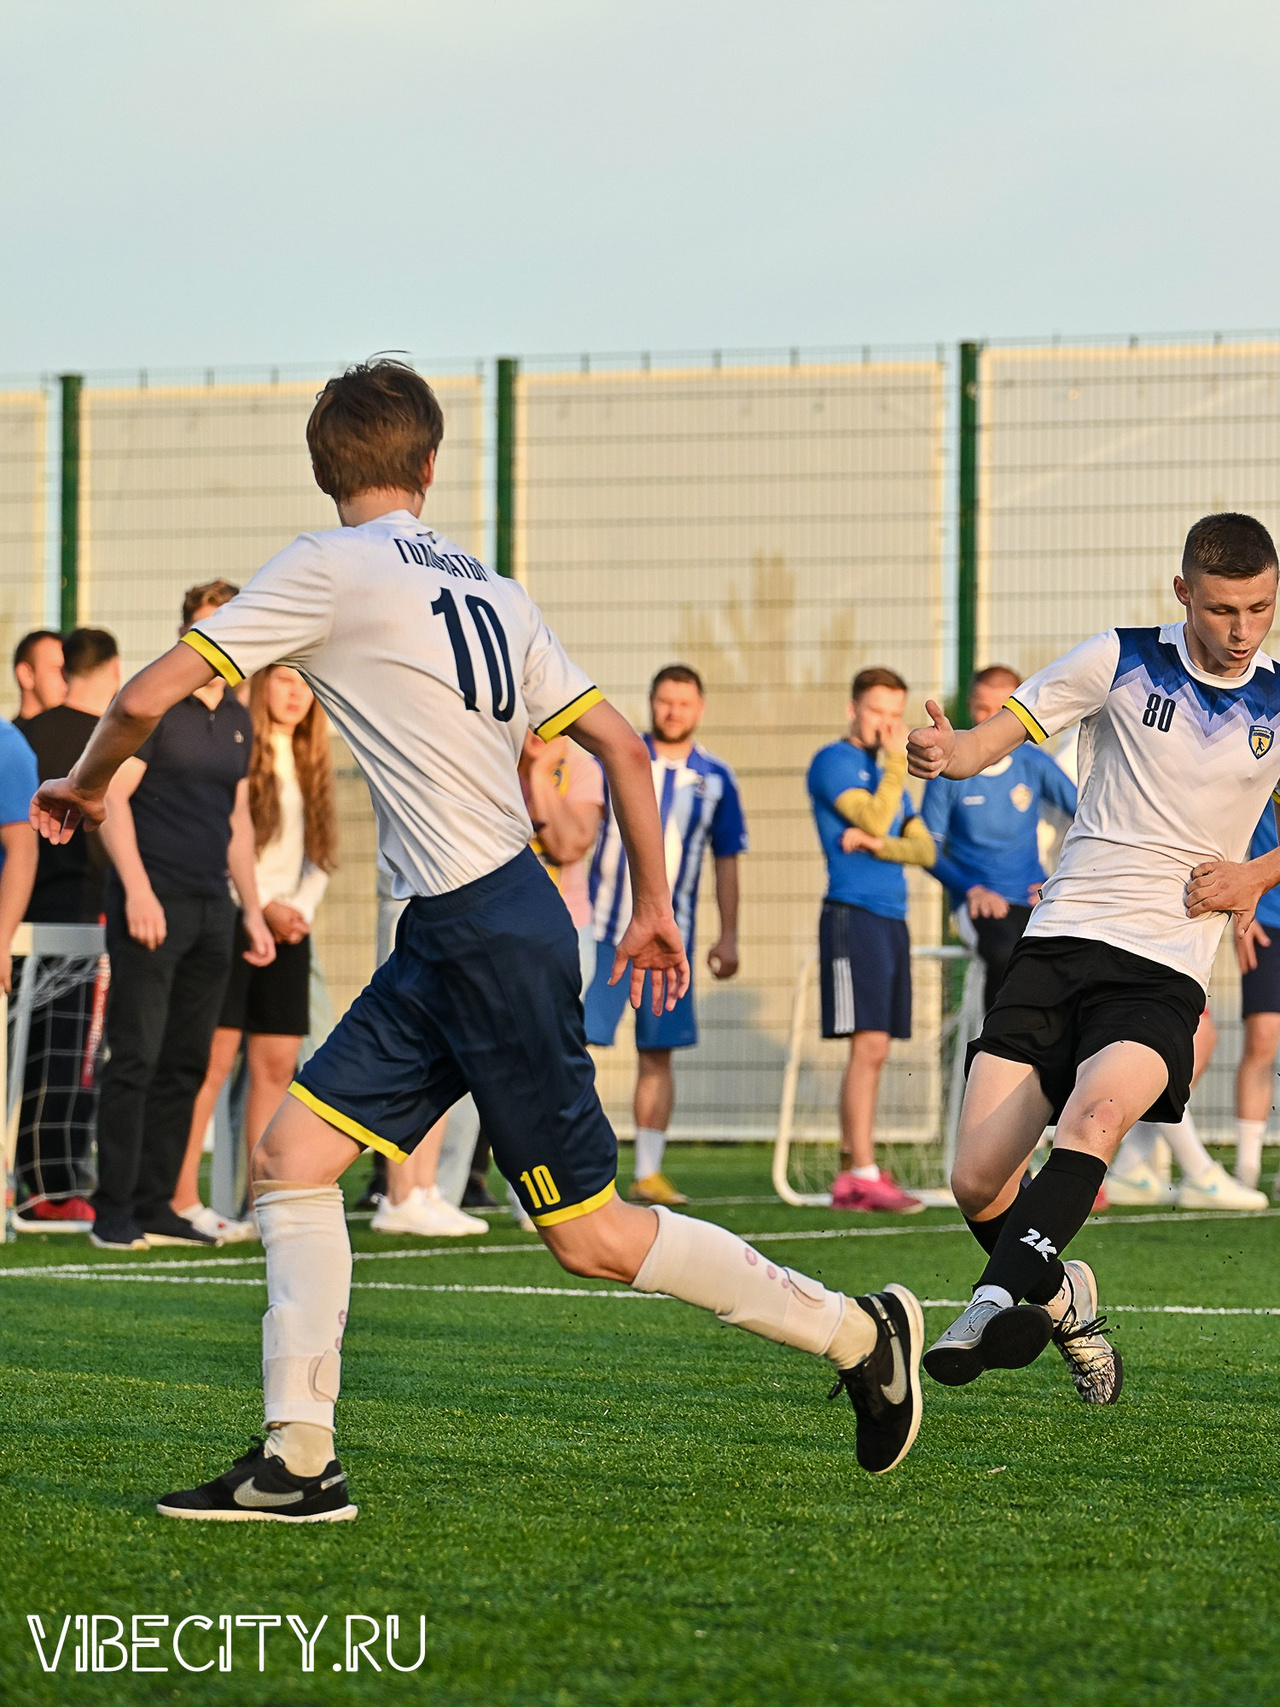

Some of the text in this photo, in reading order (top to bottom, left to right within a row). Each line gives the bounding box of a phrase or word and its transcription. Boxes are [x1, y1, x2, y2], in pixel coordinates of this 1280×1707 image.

[430, 586, 516, 723] 10
[1142, 693, 1176, 733] 80
[520, 1164, 561, 1209] 10
